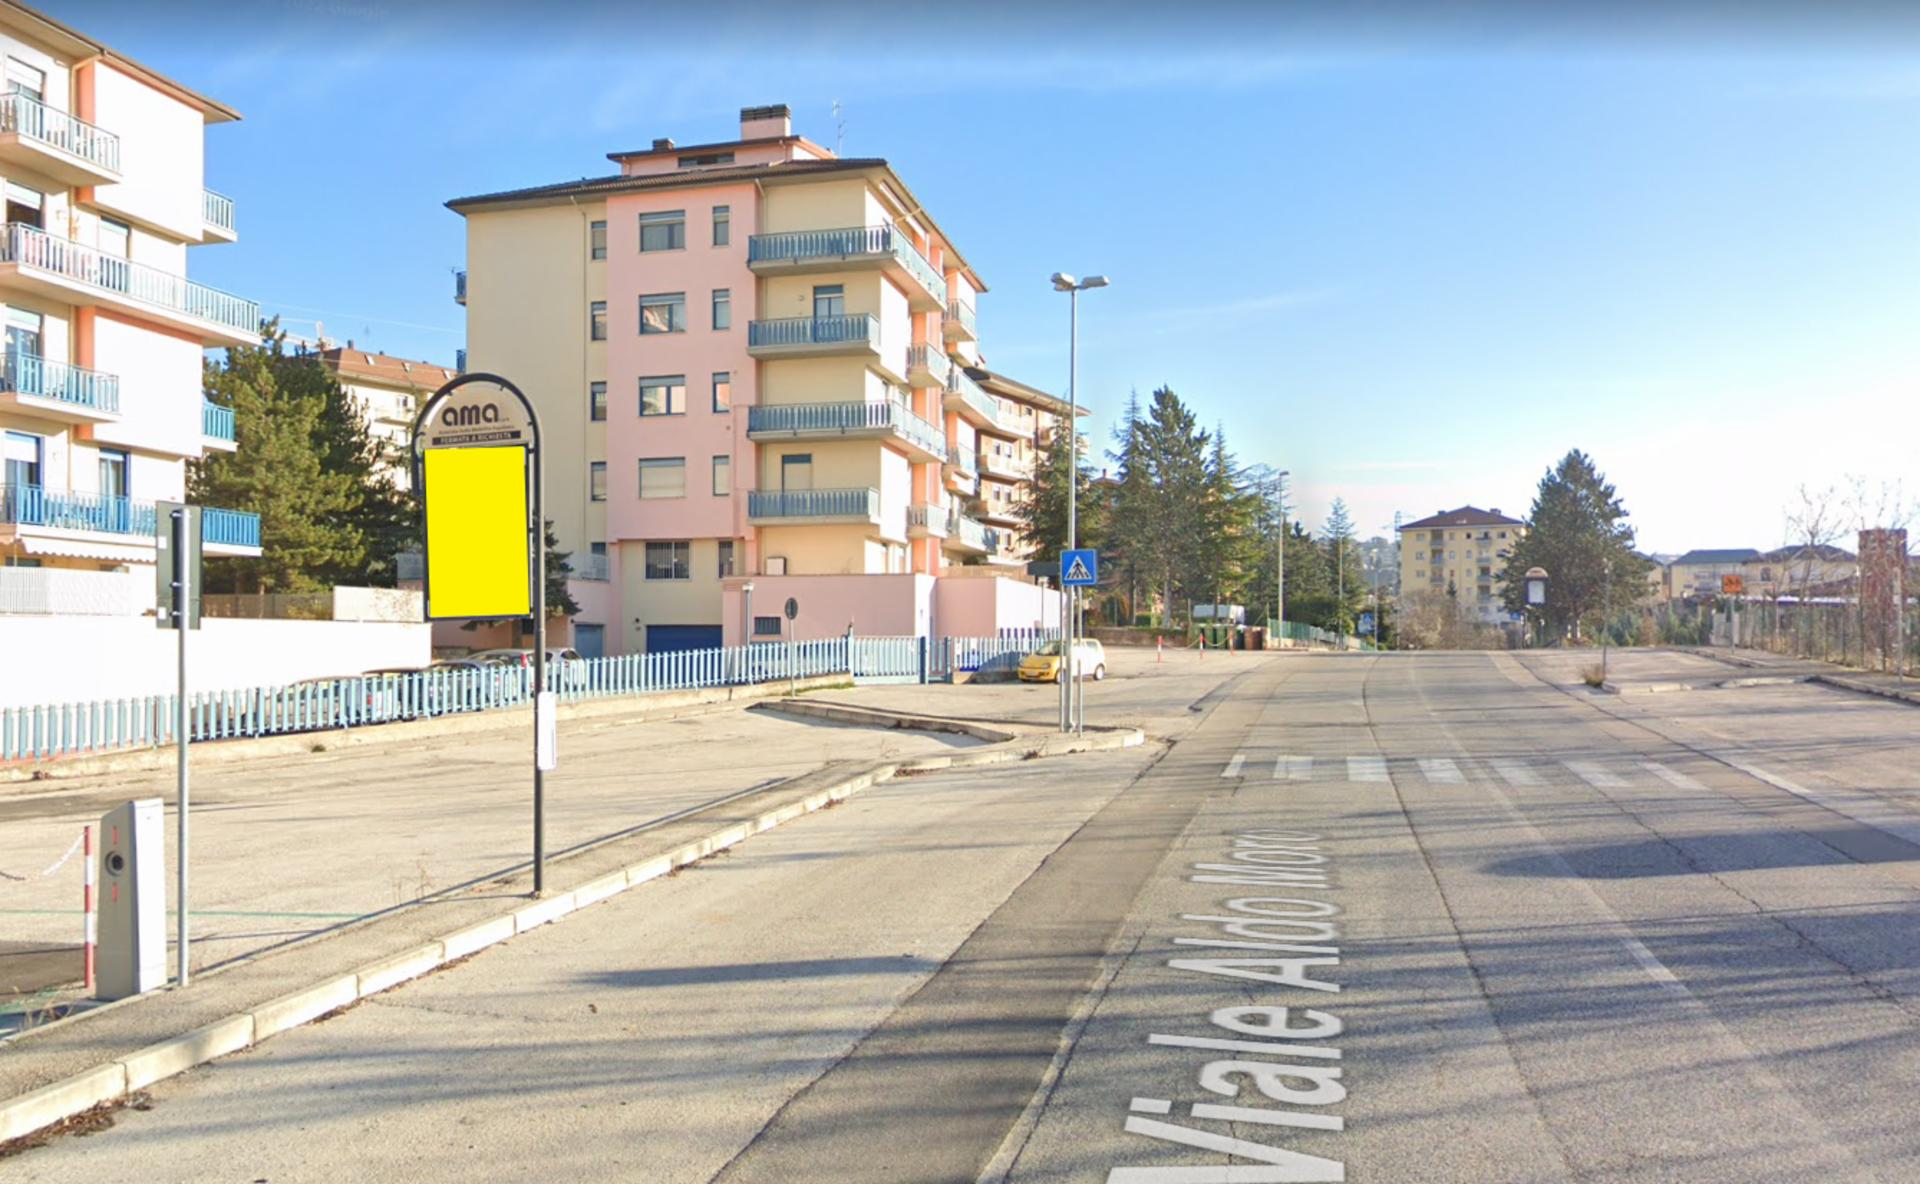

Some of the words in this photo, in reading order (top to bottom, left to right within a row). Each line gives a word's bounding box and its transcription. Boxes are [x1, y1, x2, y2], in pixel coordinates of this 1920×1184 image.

[442, 403, 499, 426] ama
[1190, 829, 1332, 889] Moro
[1167, 897, 1342, 993] Aldo
[1106, 1005, 1347, 1184] Viale
